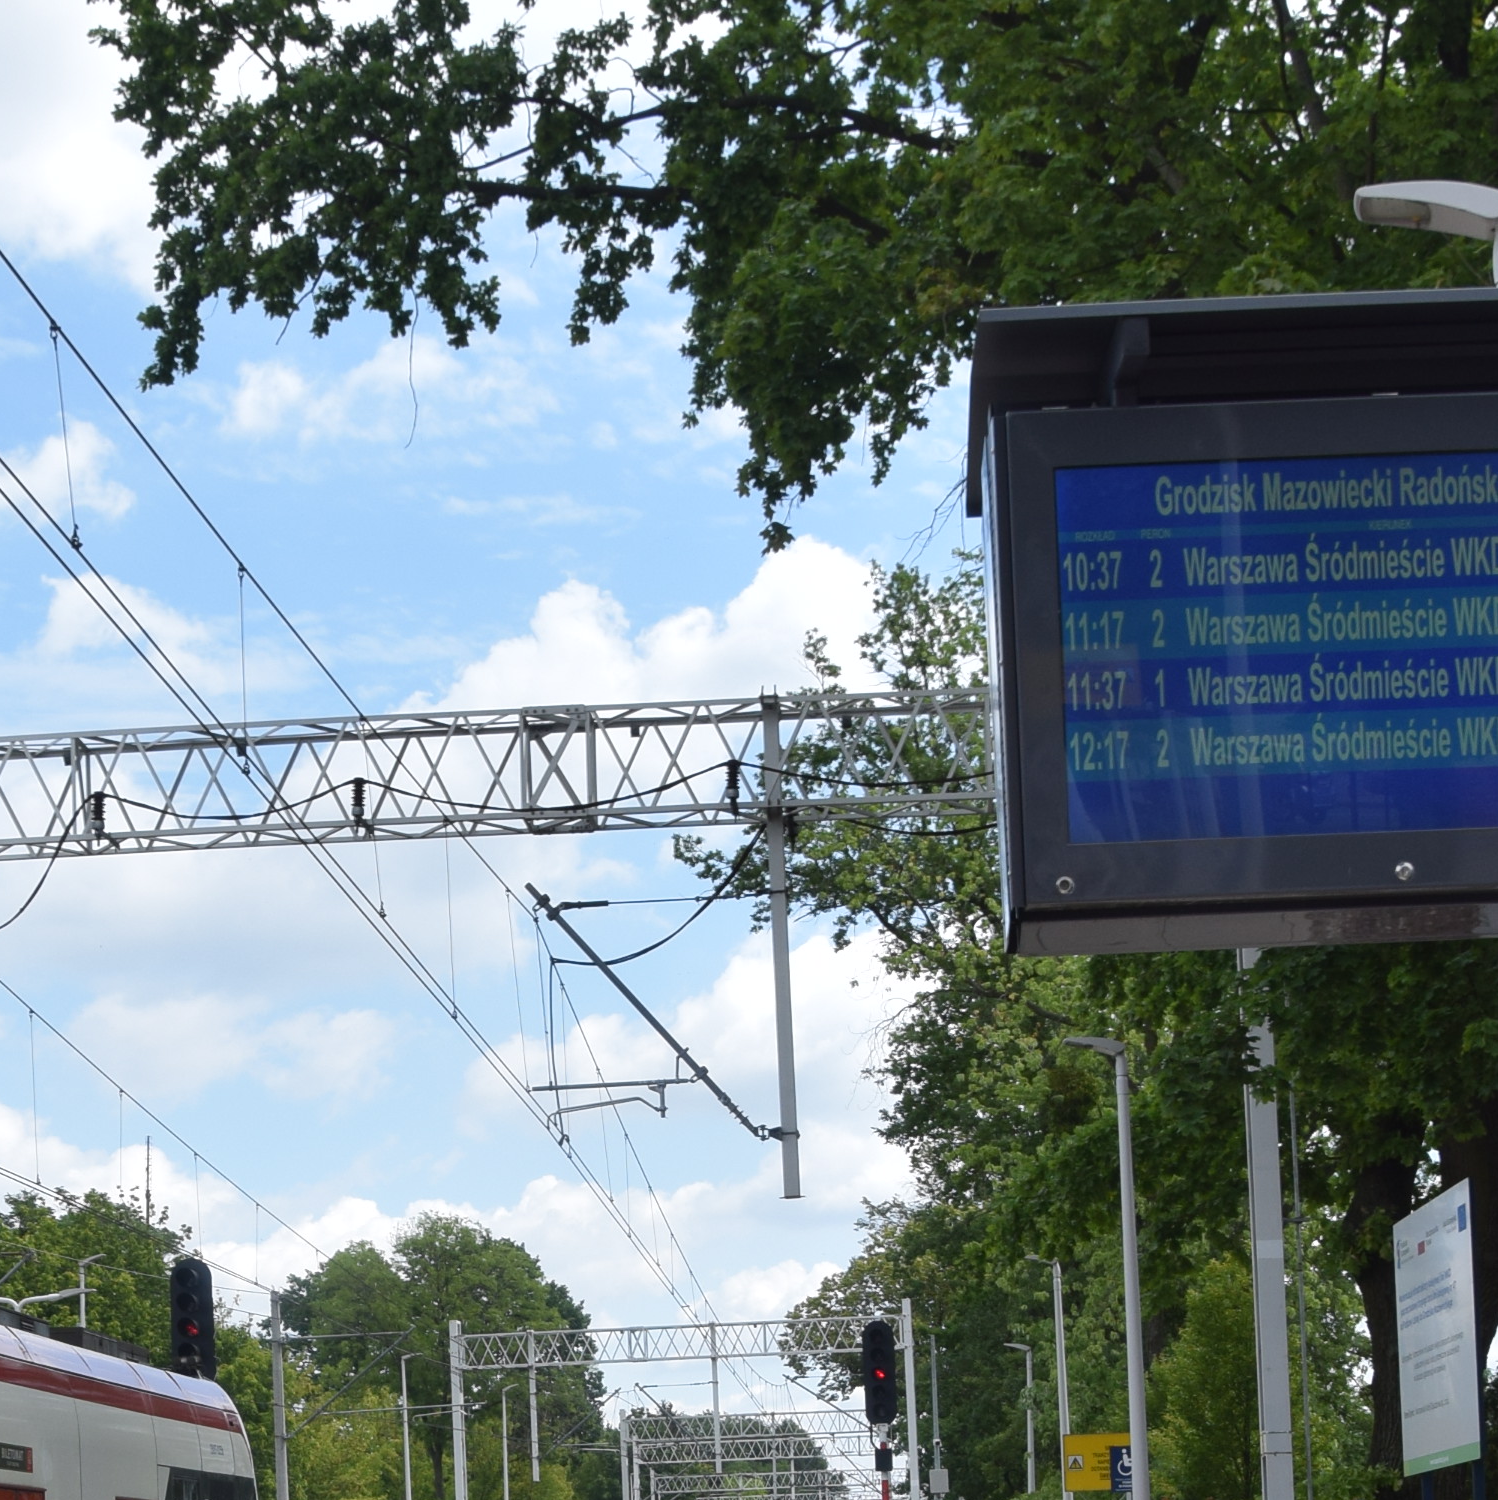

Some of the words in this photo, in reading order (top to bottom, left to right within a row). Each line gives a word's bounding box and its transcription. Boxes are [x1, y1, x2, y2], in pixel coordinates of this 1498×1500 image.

[1155, 474, 1256, 516] Grodzisk
[1262, 468, 1392, 511] Mazowiecki
[1063, 551, 1122, 591] 10:37
[1149, 549, 1163, 588] 2
[1182, 547, 1299, 586] Warszawa
[1305, 533, 1445, 582] Śródmieście
[1140, 528, 1172, 540] PERON
[1065, 610, 1125, 651] 11:17
[1151, 609, 1166, 648] 2
[1185, 606, 1301, 647] Warszawa
[1307, 593, 1448, 642] Śródmieście
[1067, 670, 1127, 711] 11:37
[1154, 670, 1166, 708] 1
[1187, 667, 1302, 707] Warszawa
[1309, 653, 1449, 702] Śródmieście
[1069, 730, 1128, 771] 12:17
[1156, 729, 1170, 768] 2
[1189, 725, 1304, 767] Warszawa
[1311, 713, 1451, 762] Śródmieście
